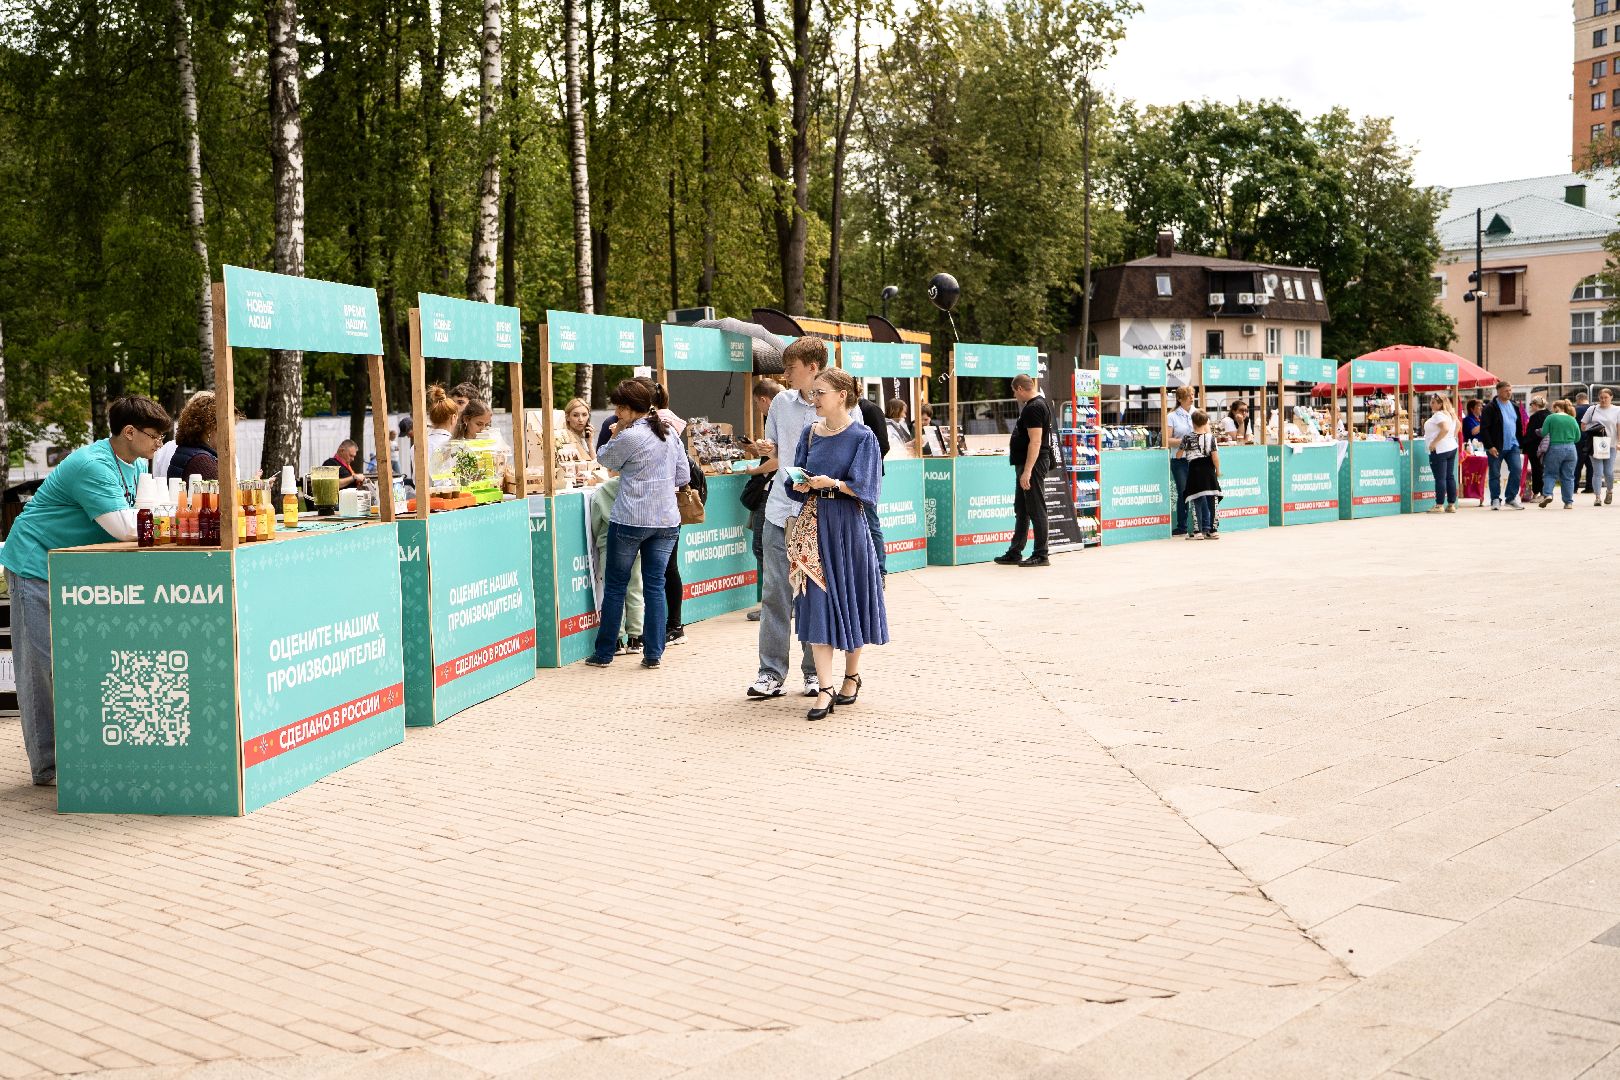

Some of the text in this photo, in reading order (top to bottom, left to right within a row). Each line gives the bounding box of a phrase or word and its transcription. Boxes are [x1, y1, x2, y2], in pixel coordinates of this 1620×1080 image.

[246, 299, 275, 315] НОВЫЕ
[343, 304, 367, 319] ВРЕМЯ
[248, 314, 272, 330] ЛЮДИ
[345, 318, 368, 331] НАШИХ
[924, 471, 950, 480] ЛЮДИ
[890, 501, 914, 513] НАШИХ
[969, 495, 1001, 507] ОЦЕНИТЕ
[529, 518, 547, 532] ДИ
[880, 511, 917, 528] ВОДИТЕЛЕЙ
[685, 525, 744, 546] ОЦЕНИТЕ НАШИХ
[972, 533, 999, 544] СДЕЛАНО
[999, 532, 1003, 540] В
[399, 545, 420, 562] ДИ
[684, 538, 747, 564] ПРОИЗВОДИТЕЛЕЙ
[888, 543, 892, 552] В
[892, 541, 914, 552] РОССИИ
[449, 570, 519, 606] ОЦЕНИТЕ НАШИХ
[690, 574, 745, 597] СДЕЛАНО В РОССИИ
[61, 583, 224, 606] НОВЫЕ ЛЮДИ
[448, 587, 523, 632] ПРОИЗВОДИТЕЛЕЙ
[269, 612, 380, 662] ОЦЕНИТЕ НАШИХ
[267, 633, 386, 695] ПРОИЗВОДИТЕЛЕЙ
[455, 636, 520, 675] СДЕЛАНО В РОССИИ
[279, 694, 380, 750] СДЕЛАНО В РОССИИ
